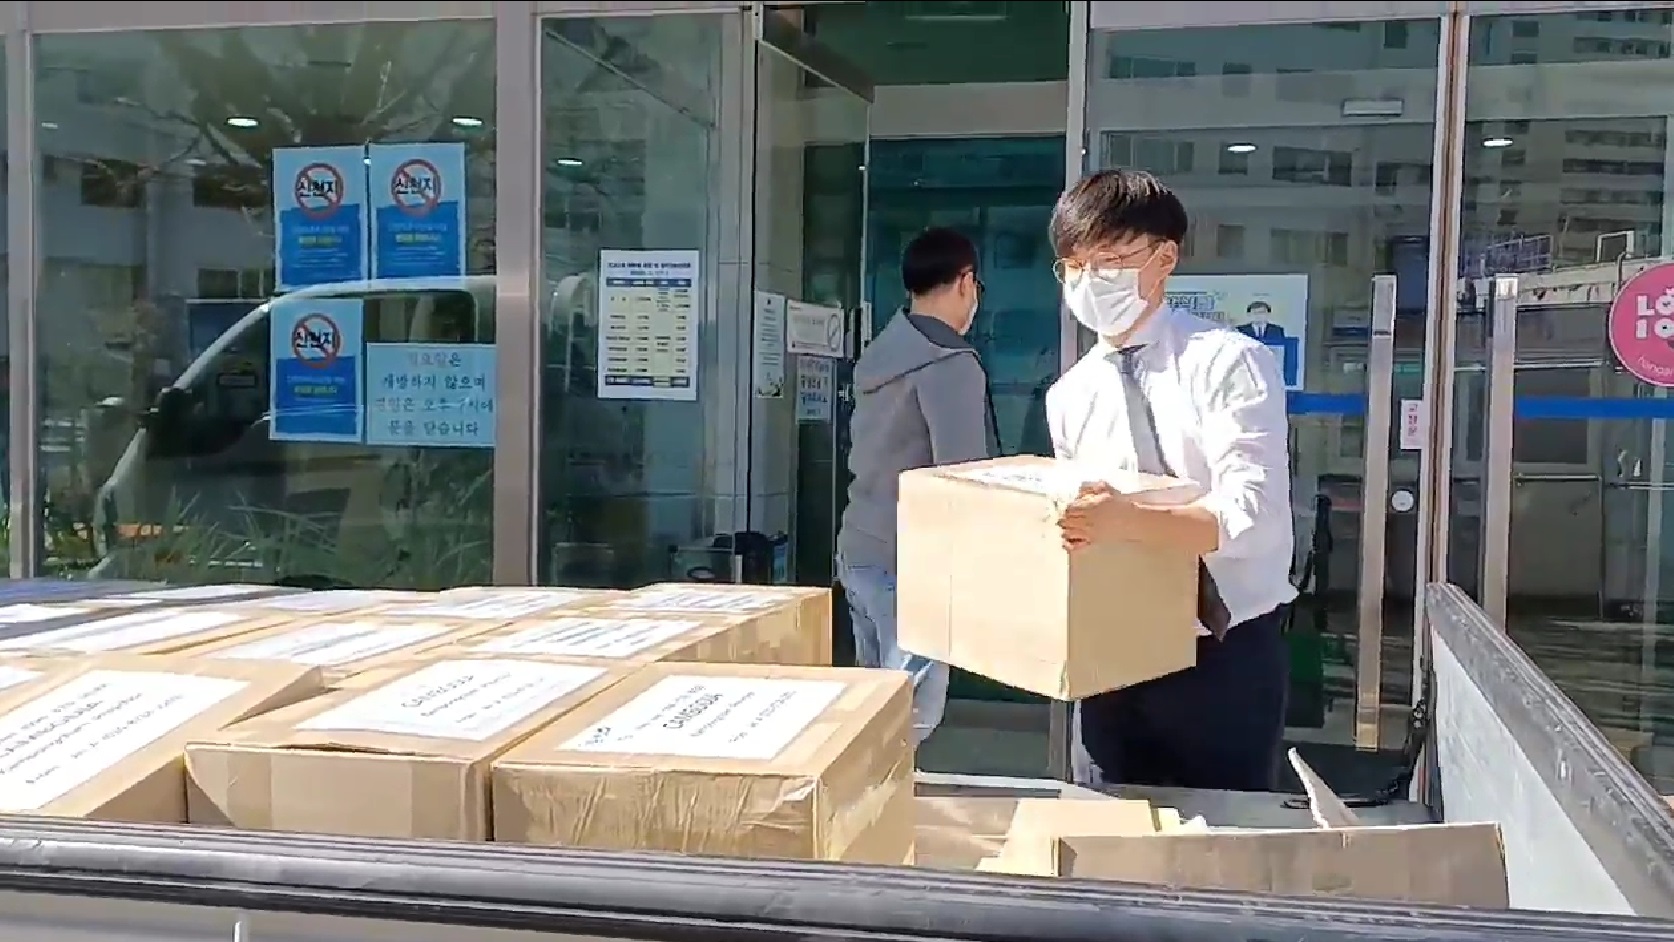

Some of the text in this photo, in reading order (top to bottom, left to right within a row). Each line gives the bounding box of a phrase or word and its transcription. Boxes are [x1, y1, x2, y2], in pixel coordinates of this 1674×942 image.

[297, 180, 338, 197] 신천지
[395, 177, 437, 195] 신천지
[296, 330, 336, 348] 신천지
[384, 373, 486, 391] 개방하지 않으며
[424, 420, 479, 437] 닫습니다
